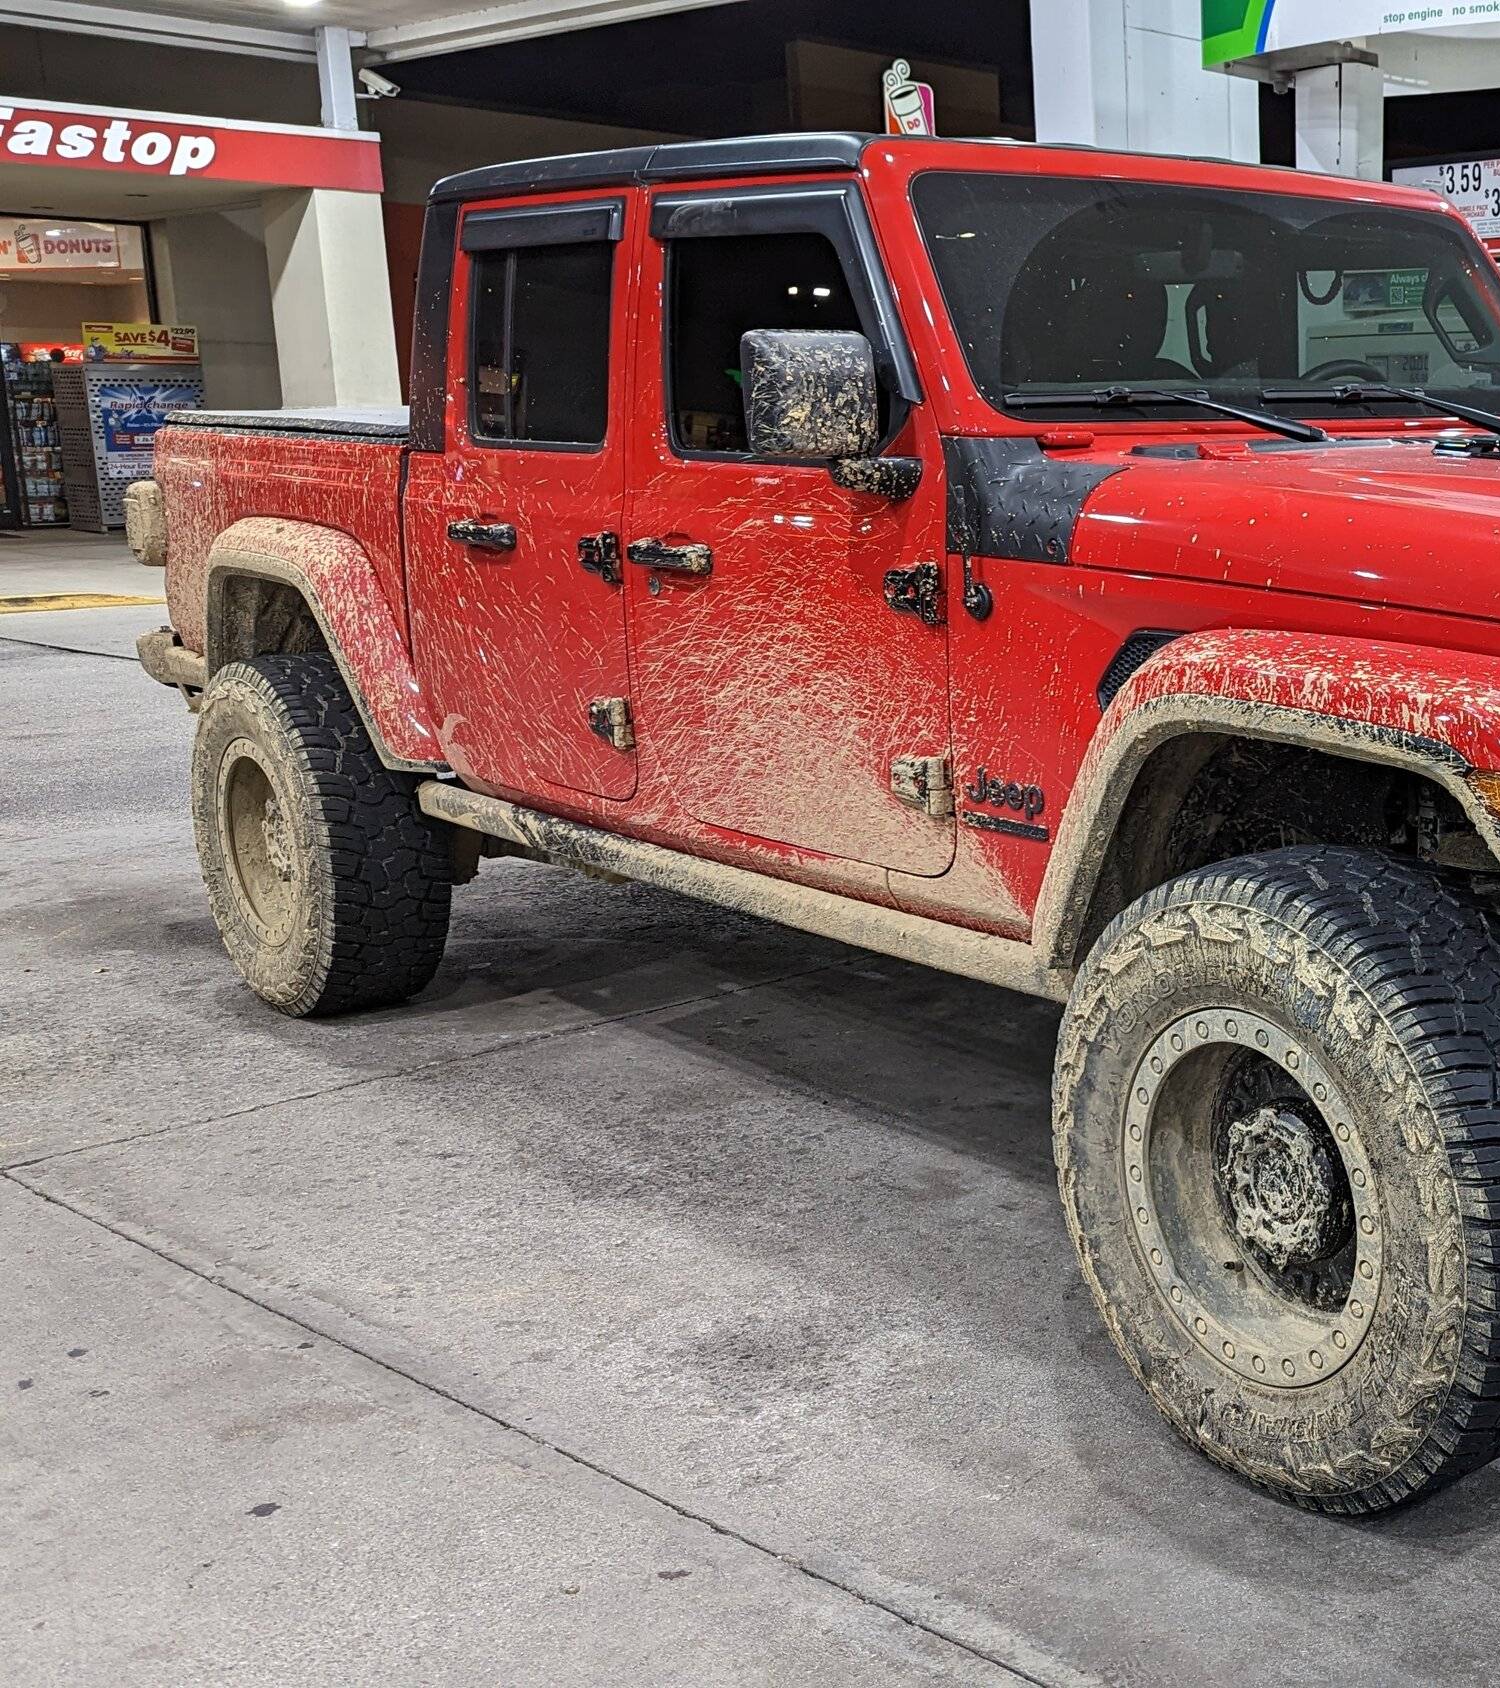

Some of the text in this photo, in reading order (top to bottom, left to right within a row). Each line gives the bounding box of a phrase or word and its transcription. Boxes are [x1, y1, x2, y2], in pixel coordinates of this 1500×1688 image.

[1383, 13, 1405, 23] stop
[1408, 8, 1443, 21] engine
[1452, 6, 1466, 15] no
[906, 118, 921, 130] DD
[1439, 163, 1482, 195] $3.59
[43, 239, 113, 254] DONUTS
[1390, 273, 1420, 285] Always
[114, 332, 147, 343] SAVE
[110, 401, 143, 411] Rapid
[965, 765, 1045, 820] Jeep
